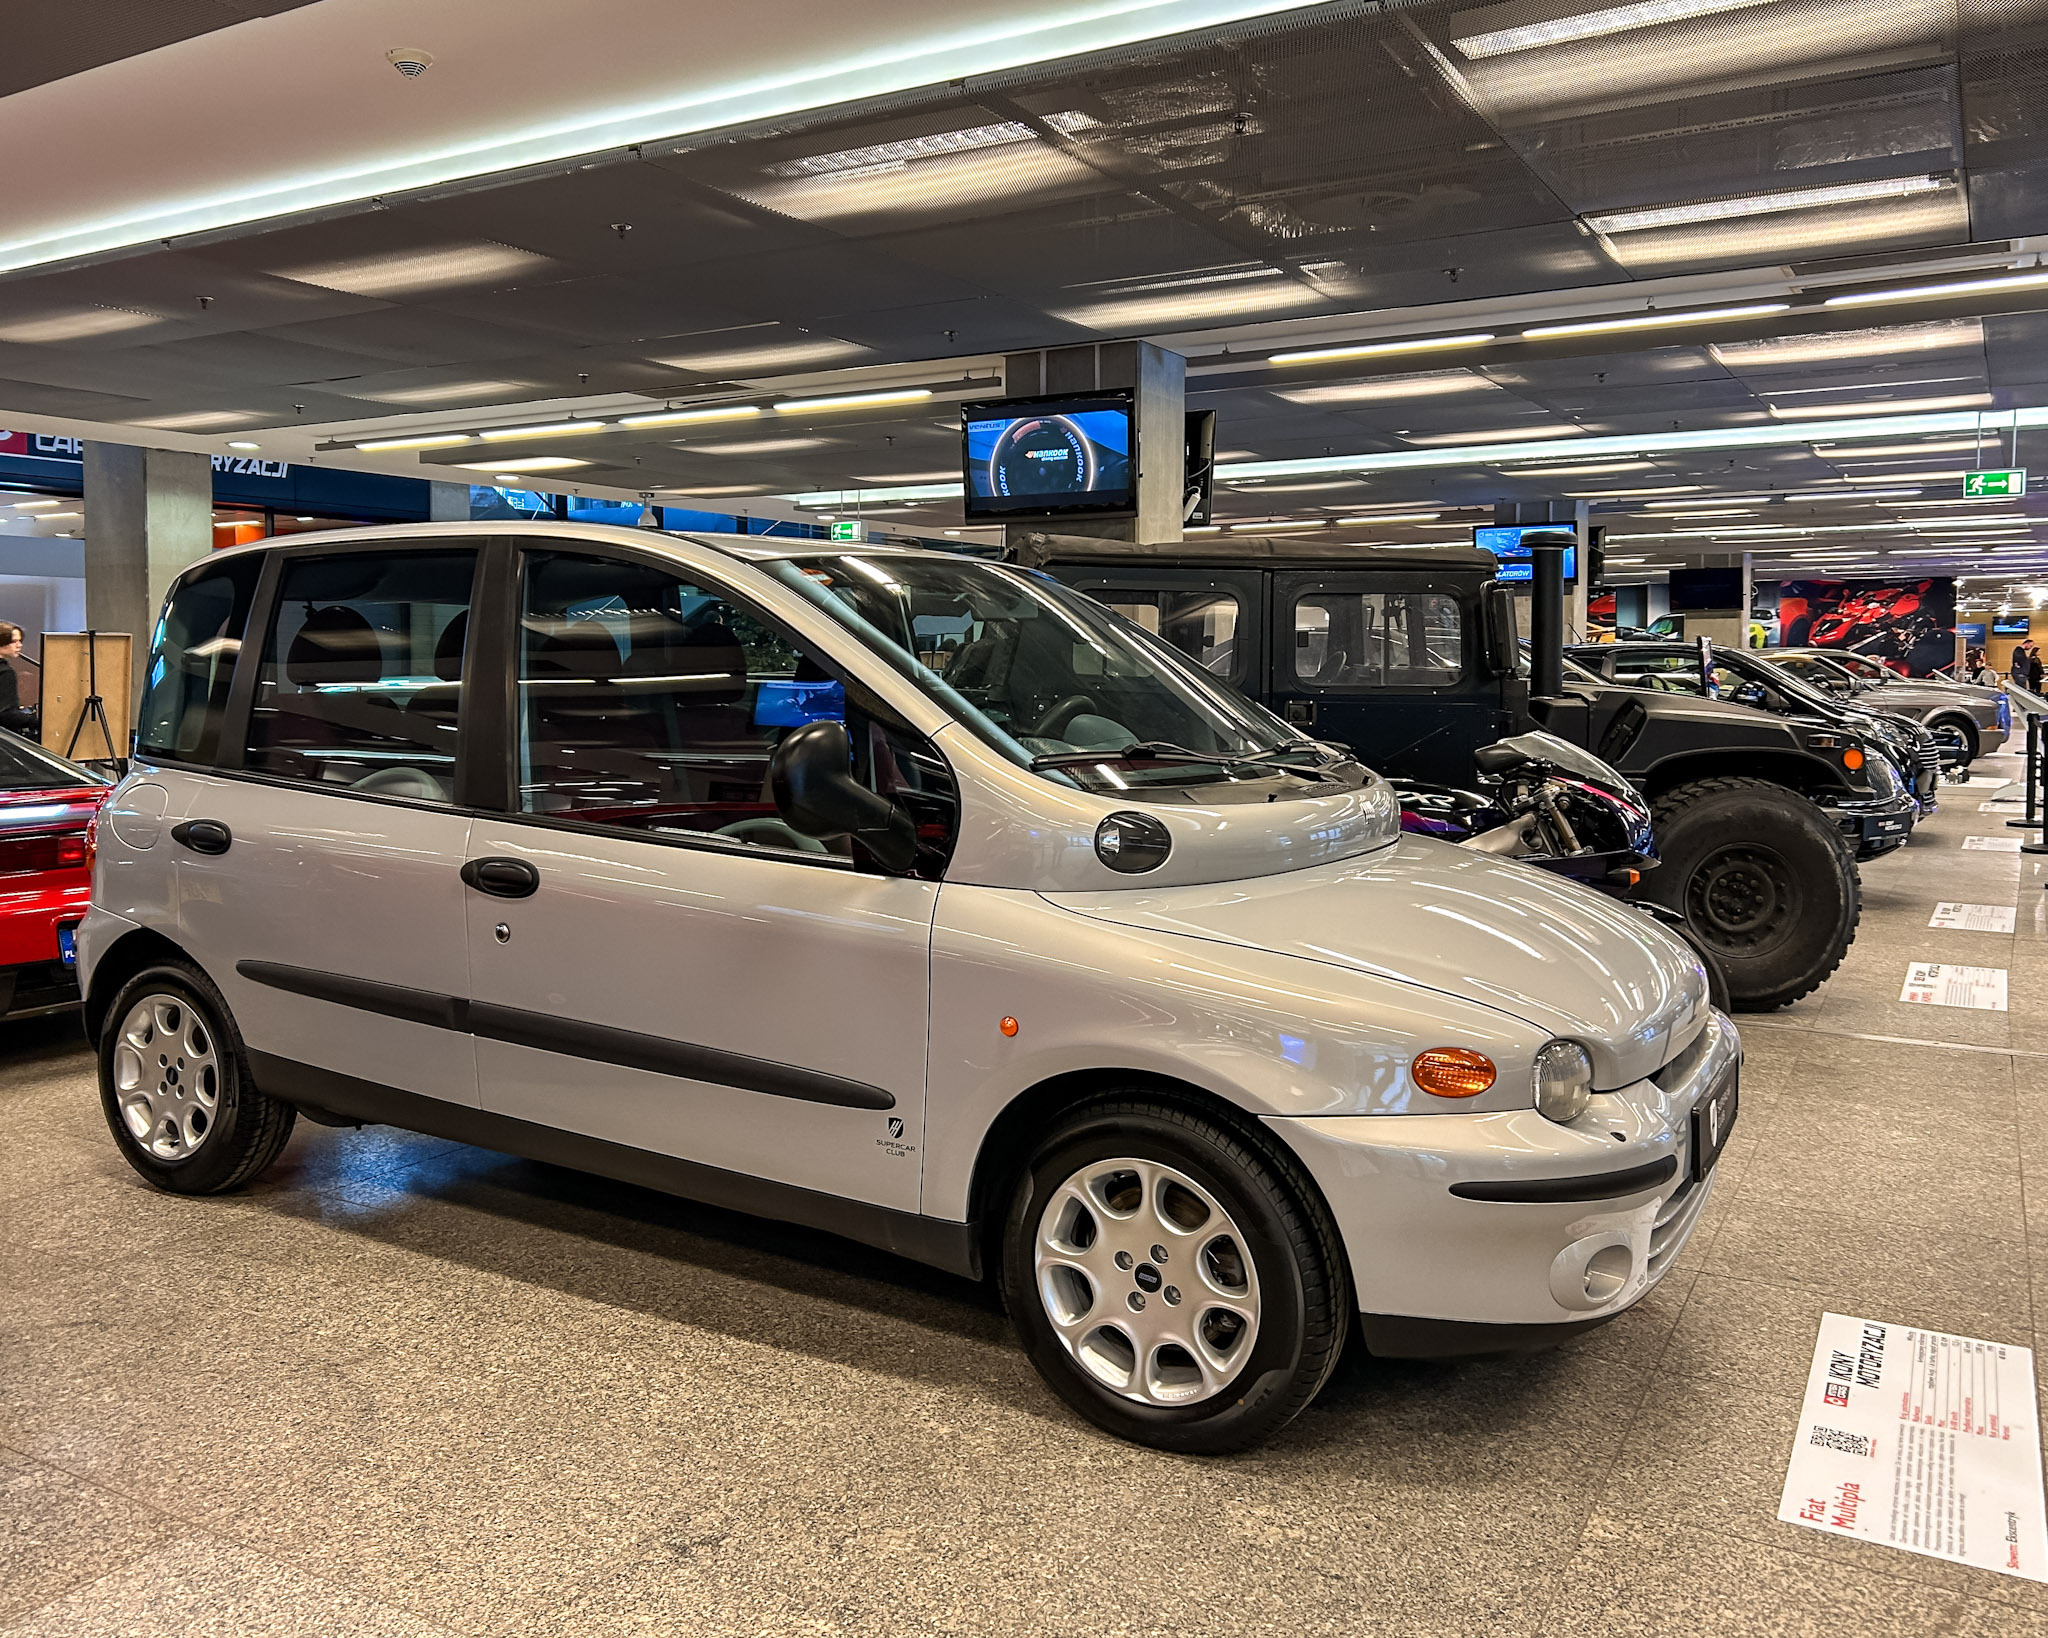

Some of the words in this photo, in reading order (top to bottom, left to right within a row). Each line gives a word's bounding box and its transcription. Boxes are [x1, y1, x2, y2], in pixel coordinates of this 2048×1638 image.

[65, 950, 75, 958] PL
[876, 1139, 916, 1153] SUPERCAR
[885, 1148, 906, 1158] CLUB
[1828, 1350, 1855, 1382] IKONY
[1856, 1322, 1887, 1389] MOTORYZACJI
[1799, 1498, 1826, 1523] Fiat
[1830, 1482, 1866, 1530] Multipla
